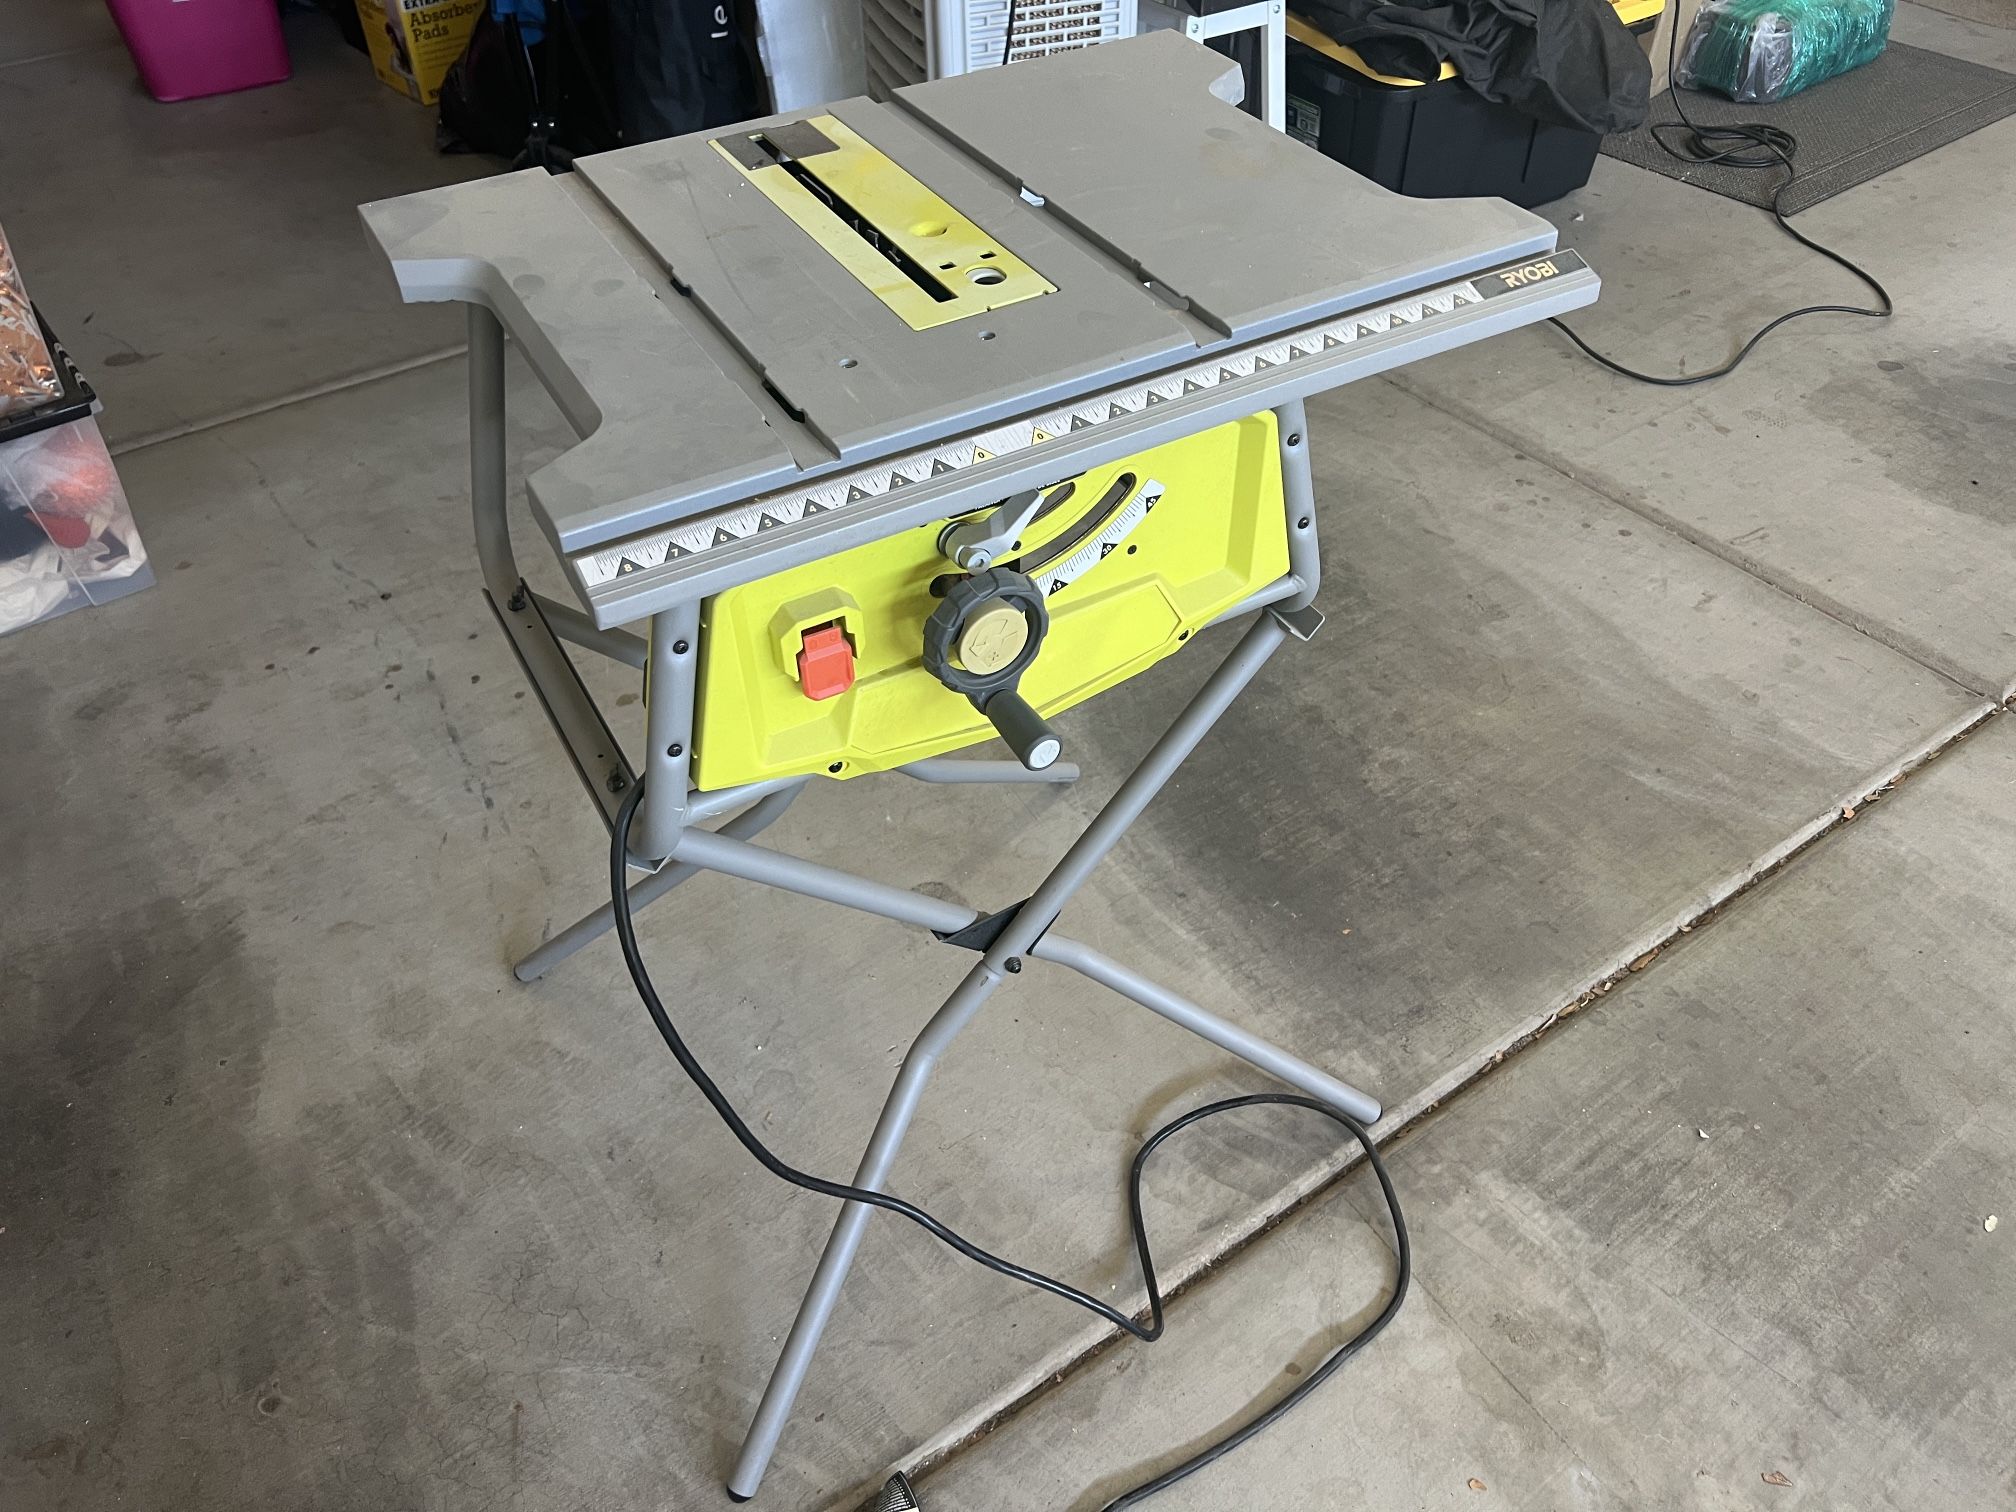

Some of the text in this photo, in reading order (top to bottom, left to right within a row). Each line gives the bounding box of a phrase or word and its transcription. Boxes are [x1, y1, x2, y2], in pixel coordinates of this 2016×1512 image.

[412, 23, 450, 42] Pads
[1500, 260, 1559, 288] RYOBI
[1148, 497, 1156, 508] 45
[624, 564, 632, 572] 8
[671, 549, 678, 557] 7
[720, 534, 728, 542] 6
[765, 519, 772, 527] 5
[809, 505, 817, 513] 4
[852, 491, 860, 499] 3
[895, 478, 903, 486] 2
[937, 464, 944, 472] 1
[1103, 545, 1112, 554] 30
[1053, 582, 1062, 591] 15
